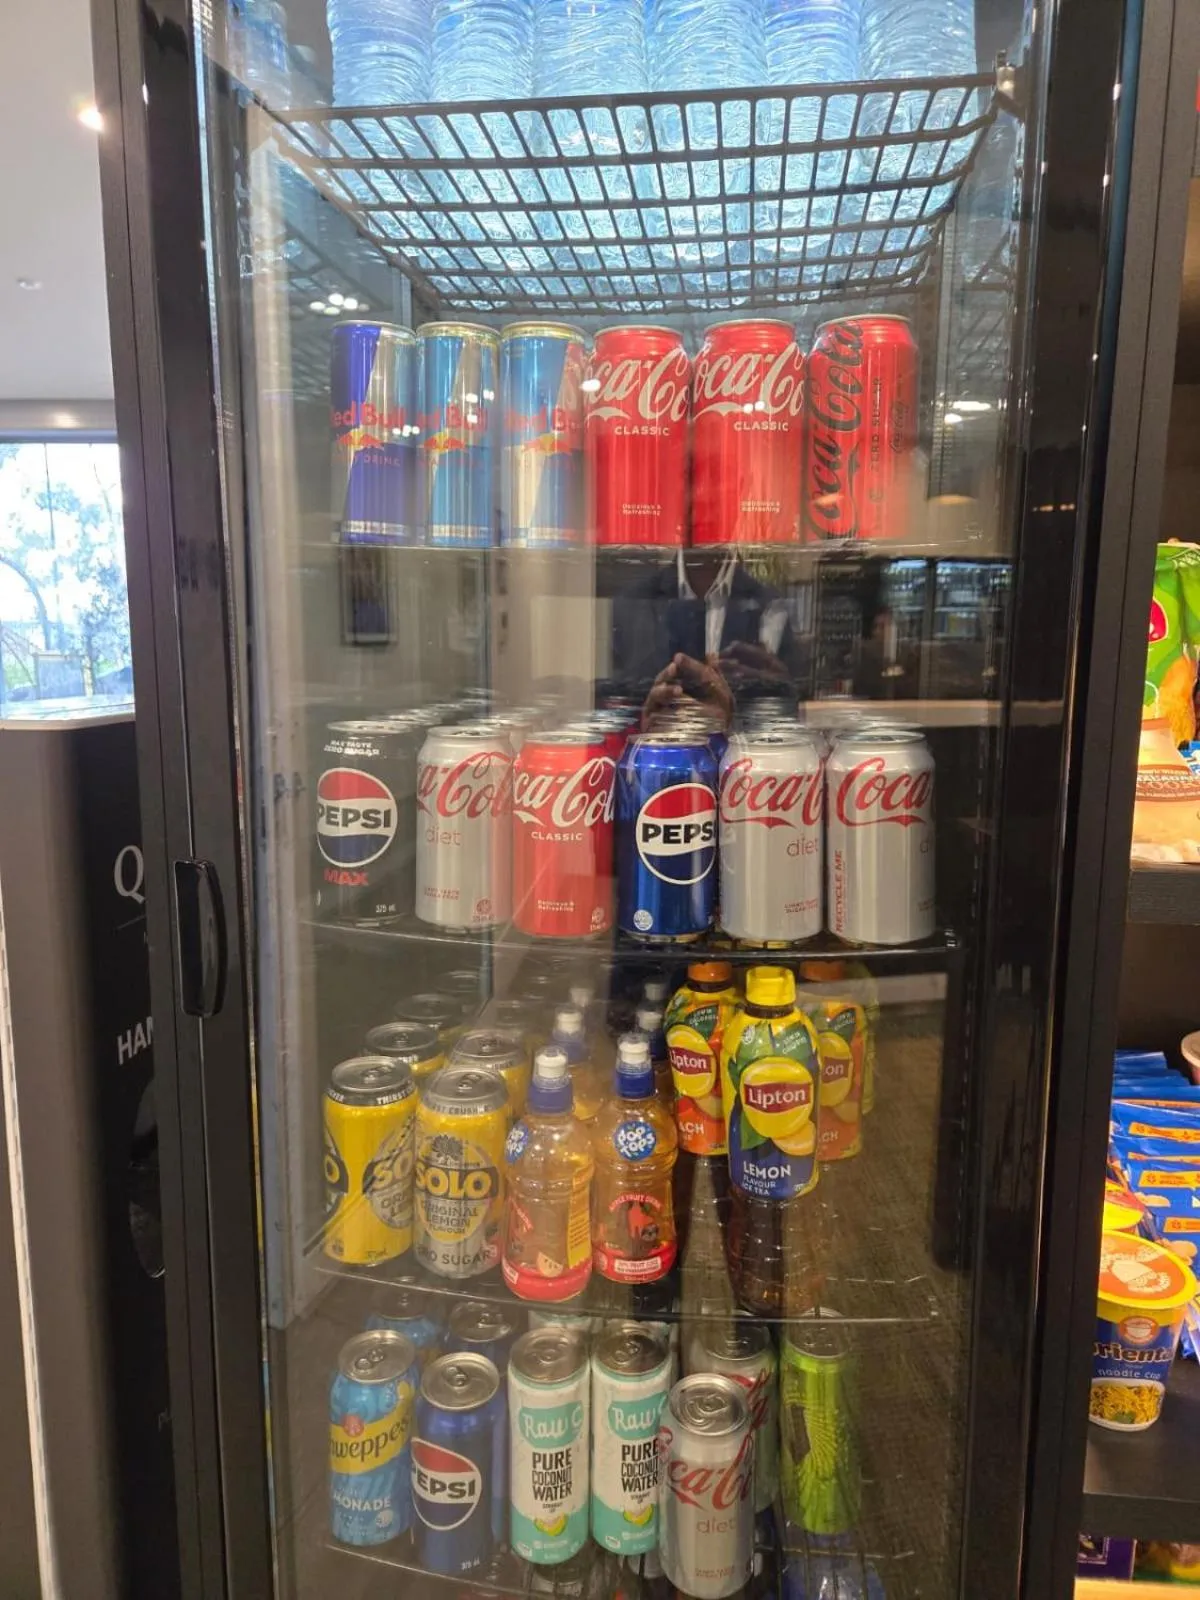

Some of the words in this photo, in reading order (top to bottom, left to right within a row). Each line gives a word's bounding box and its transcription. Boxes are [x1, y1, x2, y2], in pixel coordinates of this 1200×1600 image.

[614, 425, 670, 437] CLASSIC
[732, 420, 789, 432] CLASSIC
[426, 824, 462, 847] diet
[531, 831, 583, 841] CLASSIC
[834, 850, 843, 870] ME
[324, 868, 370, 887] MAX
[834, 873, 843, 933] RECYCLE
[670, 1049, 708, 1070] Lipton
[748, 1087, 807, 1110] Lipton
[743, 1159, 792, 1179] LEMON
[415, 1161, 492, 1199] SOLO
[743, 1175, 777, 1189] FLAVOUR
[442, 1246, 492, 1265] SUGAR
[1098, 1368, 1141, 1379] noodle
[523, 1411, 568, 1438] Raw
[571, 1406, 582, 1428] C
[612, 1404, 657, 1432] Raw
[532, 1447, 573, 1470] PURE
[621, 1437, 660, 1462] PURE
[531, 1466, 573, 1487] COCONUT
[620, 1456, 660, 1477] COCONUT
[413, 1463, 476, 1499] EPSI
[621, 1474, 660, 1493] WATER
[532, 1485, 573, 1502] WATER
[696, 1516, 738, 1534] diet
